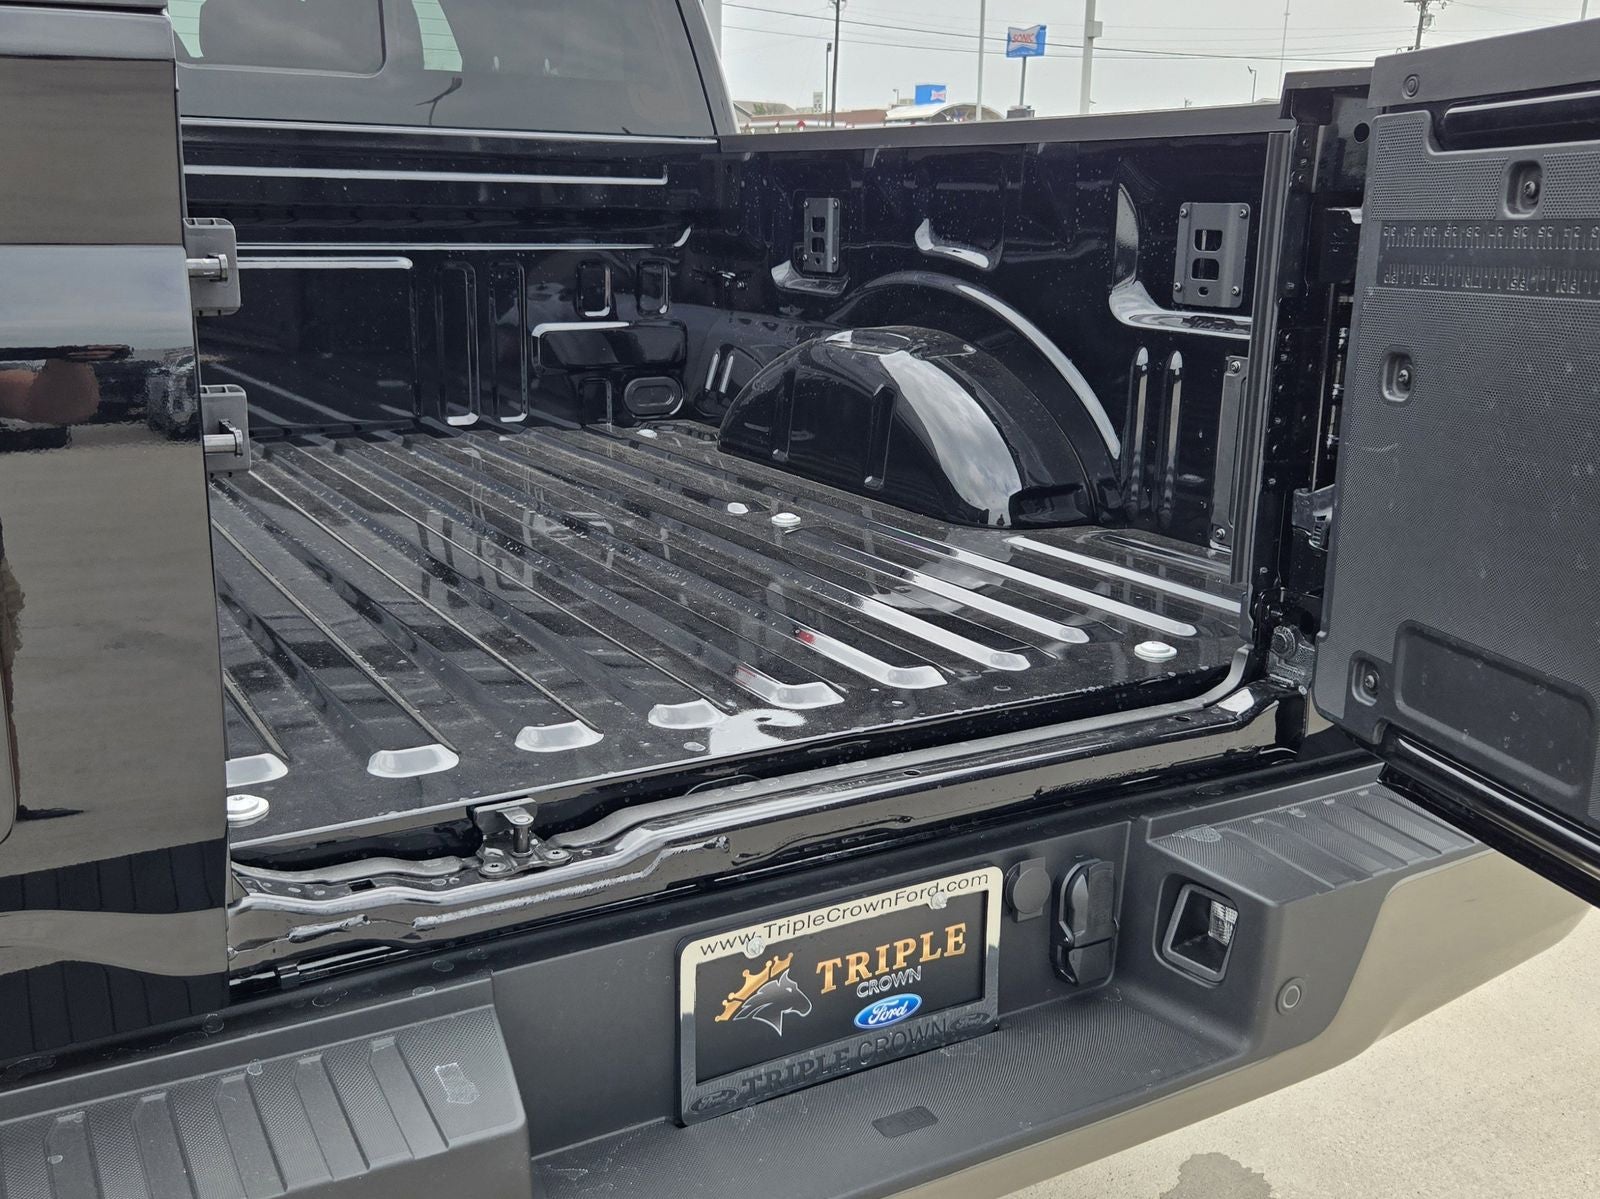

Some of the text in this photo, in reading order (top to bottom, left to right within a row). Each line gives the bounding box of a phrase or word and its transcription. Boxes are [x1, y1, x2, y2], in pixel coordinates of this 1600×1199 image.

[1011, 32, 1034, 43] SONIC
[700, 872, 989, 957] www.TripleCrownFord.com
[815, 921, 967, 995] TRIPLE
[856, 965, 922, 998] CROWN
[867, 999, 909, 1025] Ford
[741, 1047, 850, 1098] TRIPLE
[858, 1017, 947, 1065] CROWN
